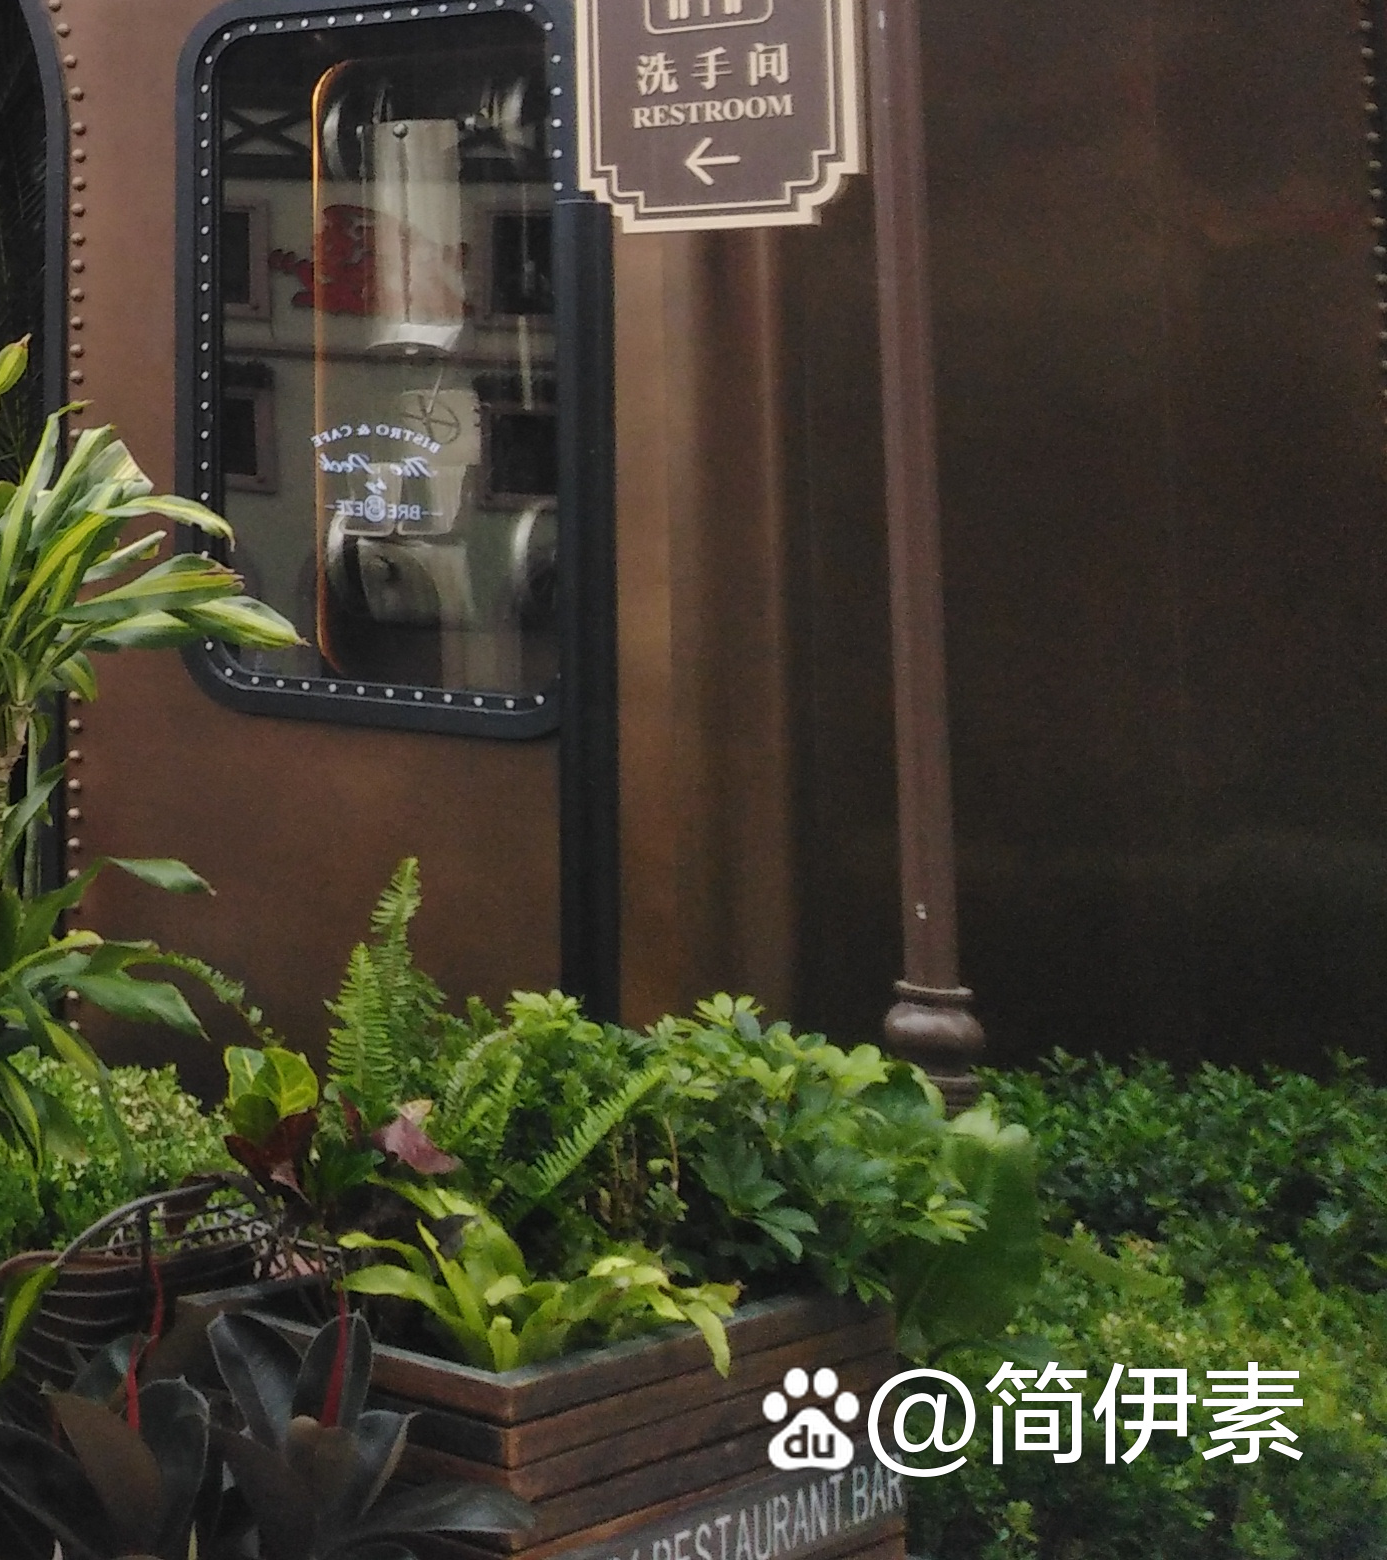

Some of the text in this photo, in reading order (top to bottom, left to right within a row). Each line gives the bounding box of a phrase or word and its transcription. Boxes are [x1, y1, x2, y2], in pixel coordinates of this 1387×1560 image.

[635, 42, 792, 96] 洗手间
[631, 93, 795, 130] RESTROOM
